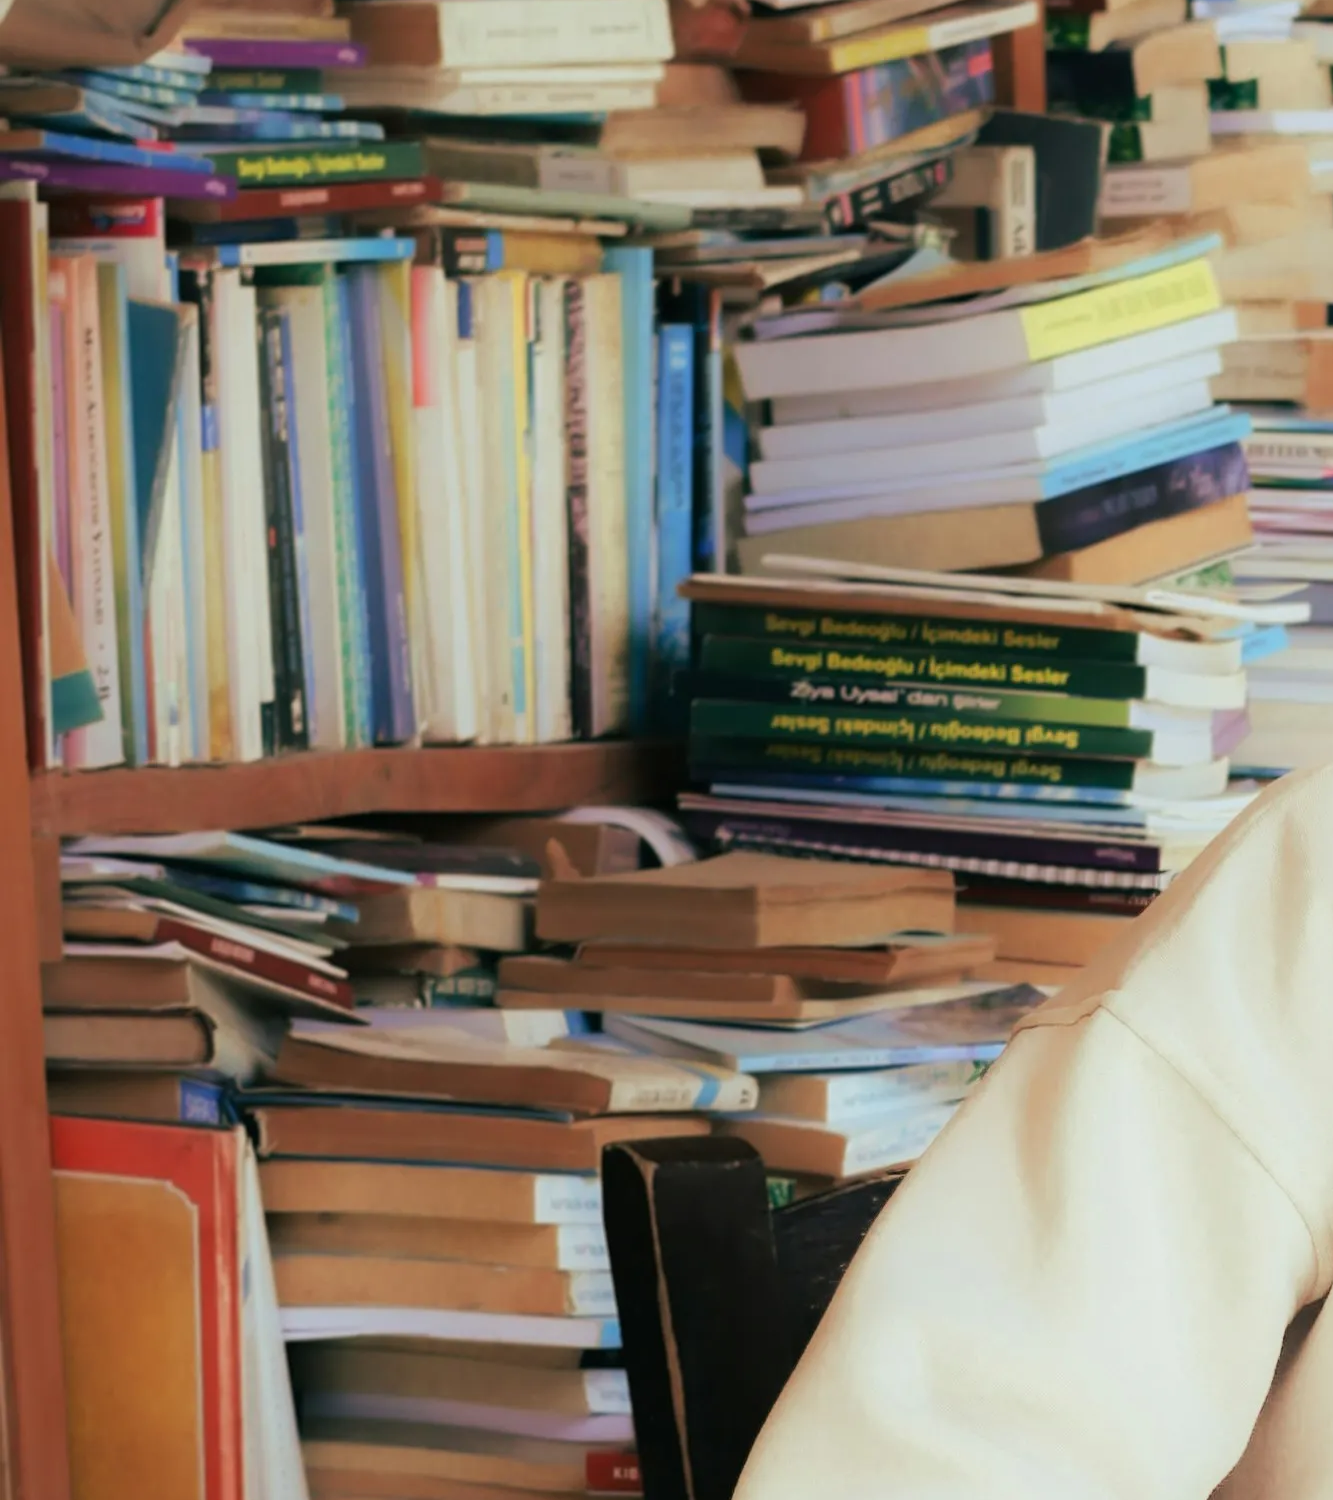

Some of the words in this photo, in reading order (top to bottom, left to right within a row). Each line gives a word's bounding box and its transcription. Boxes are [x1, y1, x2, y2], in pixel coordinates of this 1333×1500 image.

[764, 613, 817, 637] Sevgi
[820, 616, 908, 641] Bedeoğlu
[921, 620, 998, 648] İçimdeki
[1002, 628, 1061, 650] Sesler
[770, 647, 824, 675] Sevgi
[826, 651, 915, 678] Bedeoğlu
[928, 653, 1006, 681] İçimdeki
[1010, 665, 1071, 687] Sesler
[770, 713, 830, 735] Sesler
[834, 716, 915, 742] İçimdeki
[929, 721, 1020, 746] Bedeoğlu
[1024, 726, 1080, 750] Sevgi
